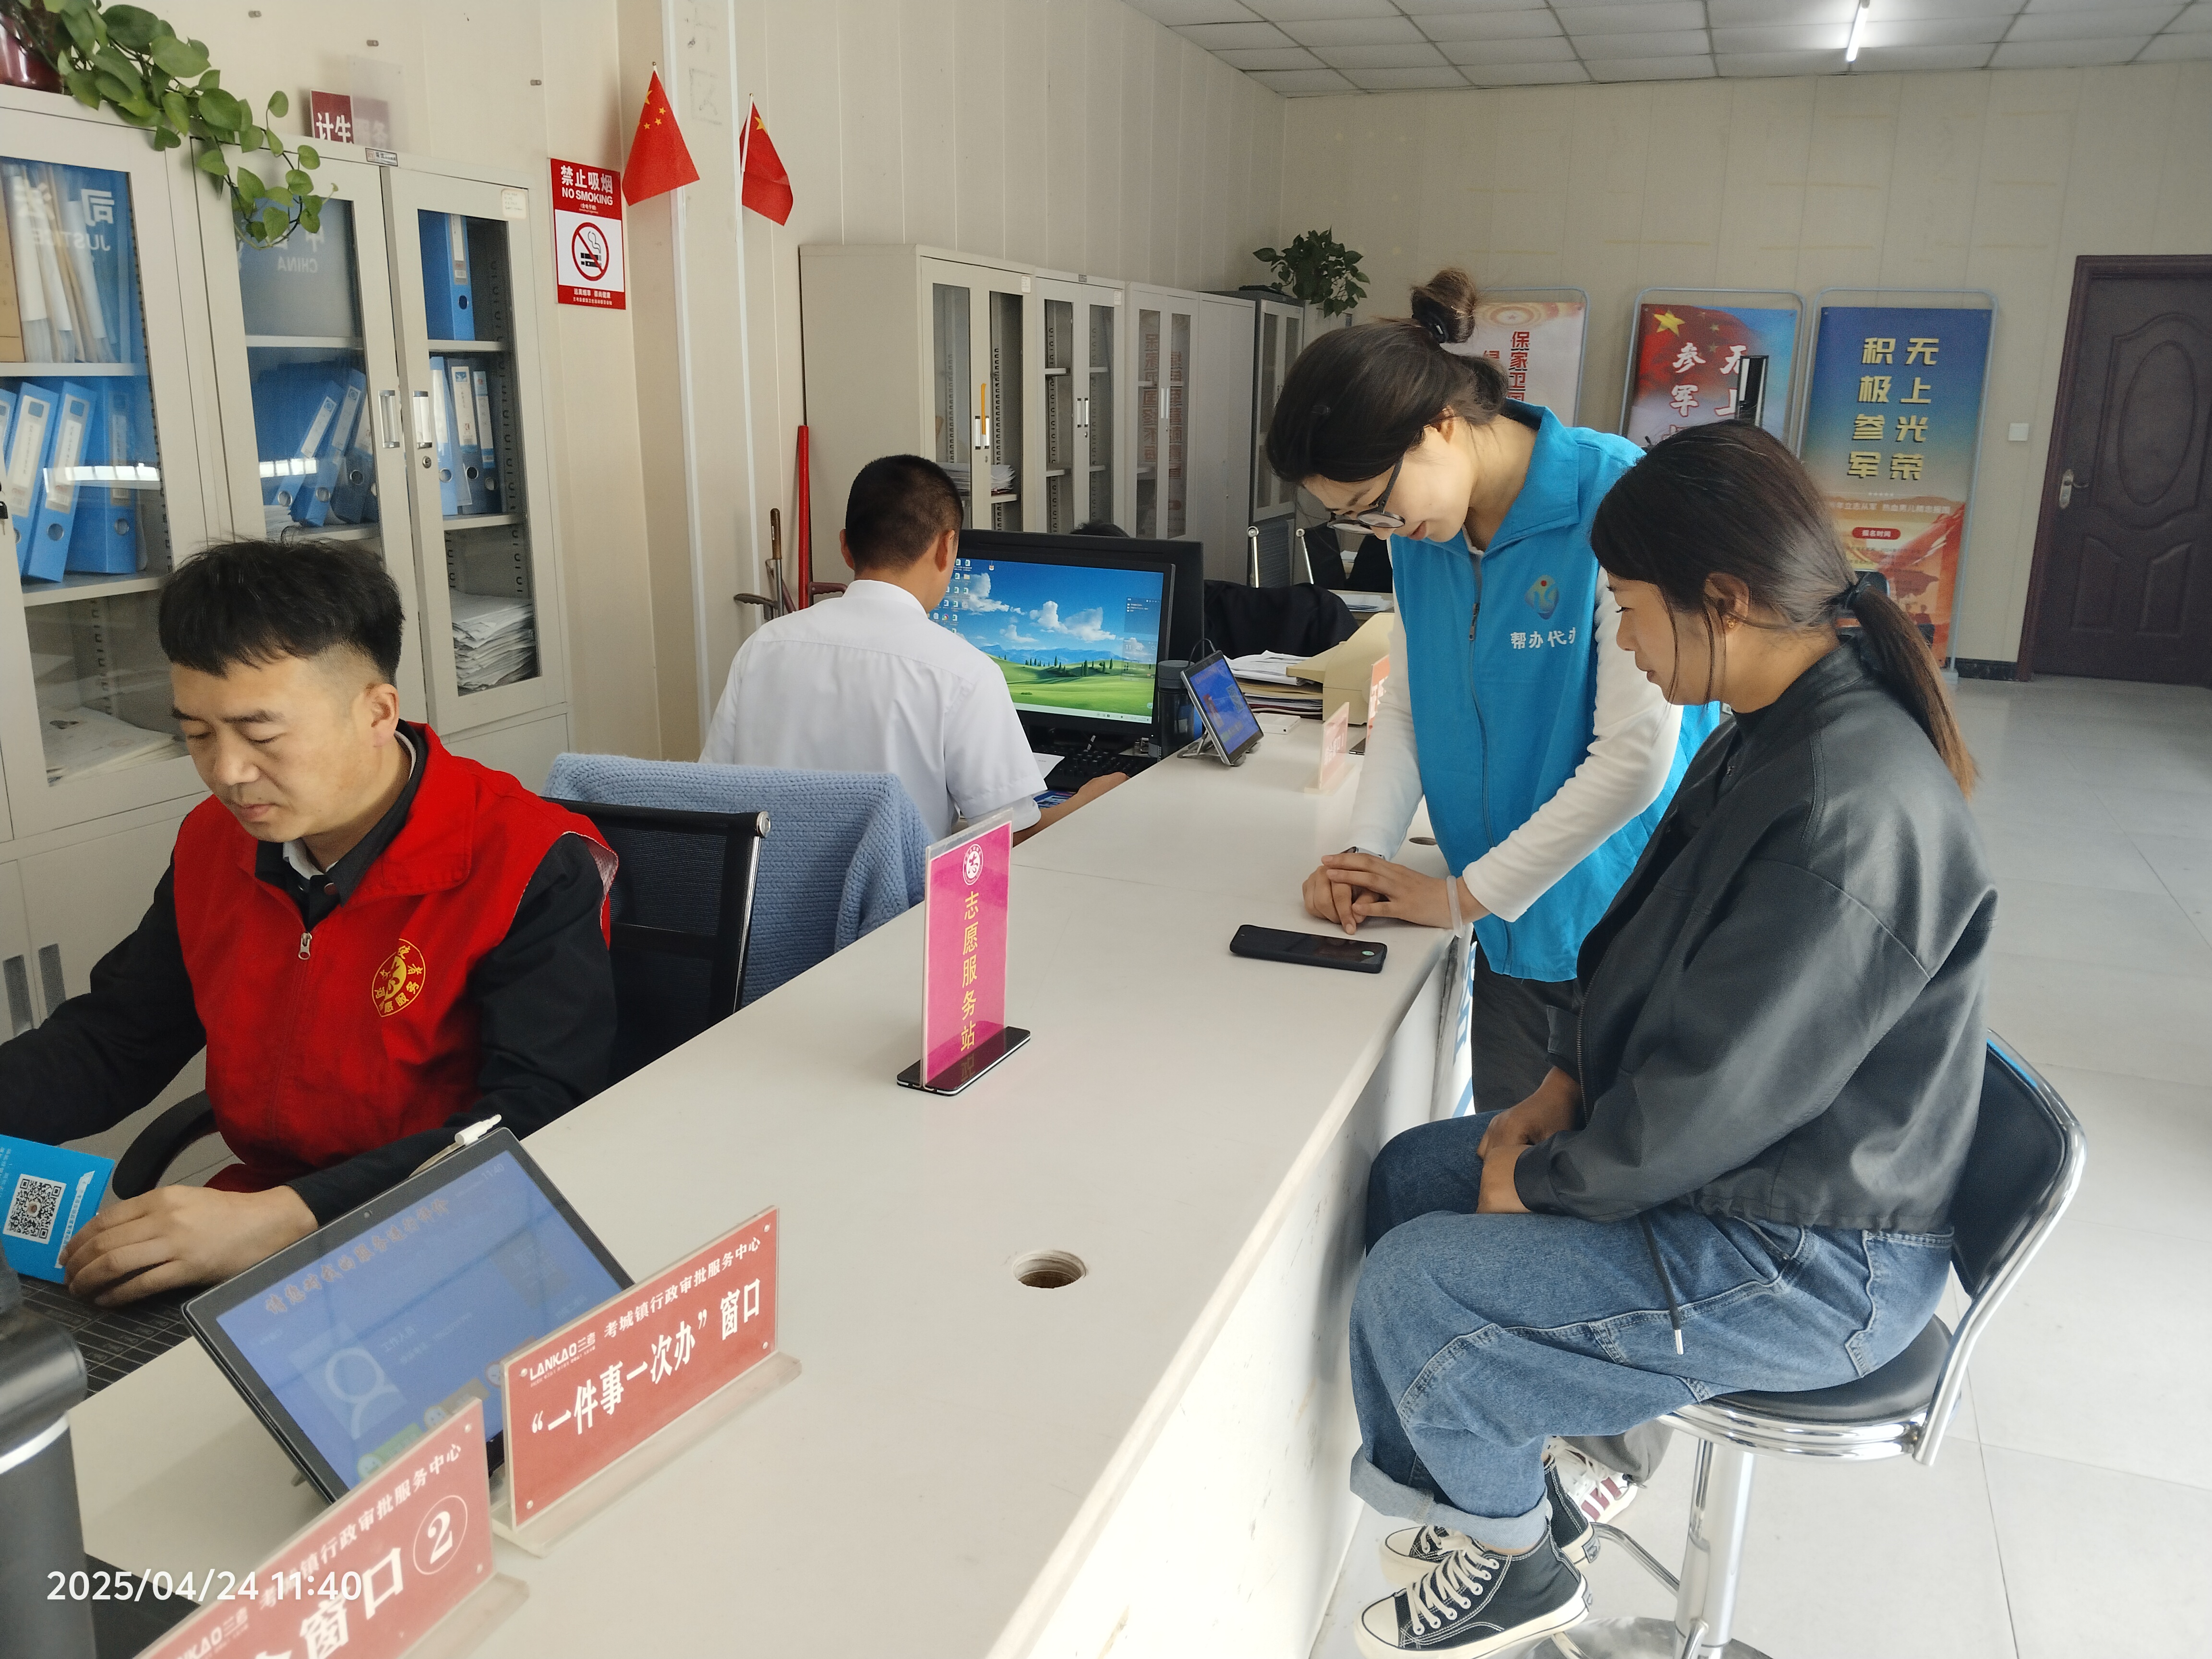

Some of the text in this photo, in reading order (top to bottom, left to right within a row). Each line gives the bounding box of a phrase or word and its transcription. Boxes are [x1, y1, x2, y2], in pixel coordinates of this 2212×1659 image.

[561, 165, 613, 194] 禁止吸烟
[562, 187, 613, 205] NO SMOKING
[1847, 337, 1896, 479] 积极参军
[1891, 337, 1939, 481] 无上光荣
[961, 890, 980, 1051] 志愿服务站
[266, 1198, 450, 1314] 请您对我的服务进行评价
[604, 1237, 761, 1338] 考城镇行政审批服务中心
[720, 1278, 761, 1341] 窗口
[255, 1547, 404, 1659] 窗口
